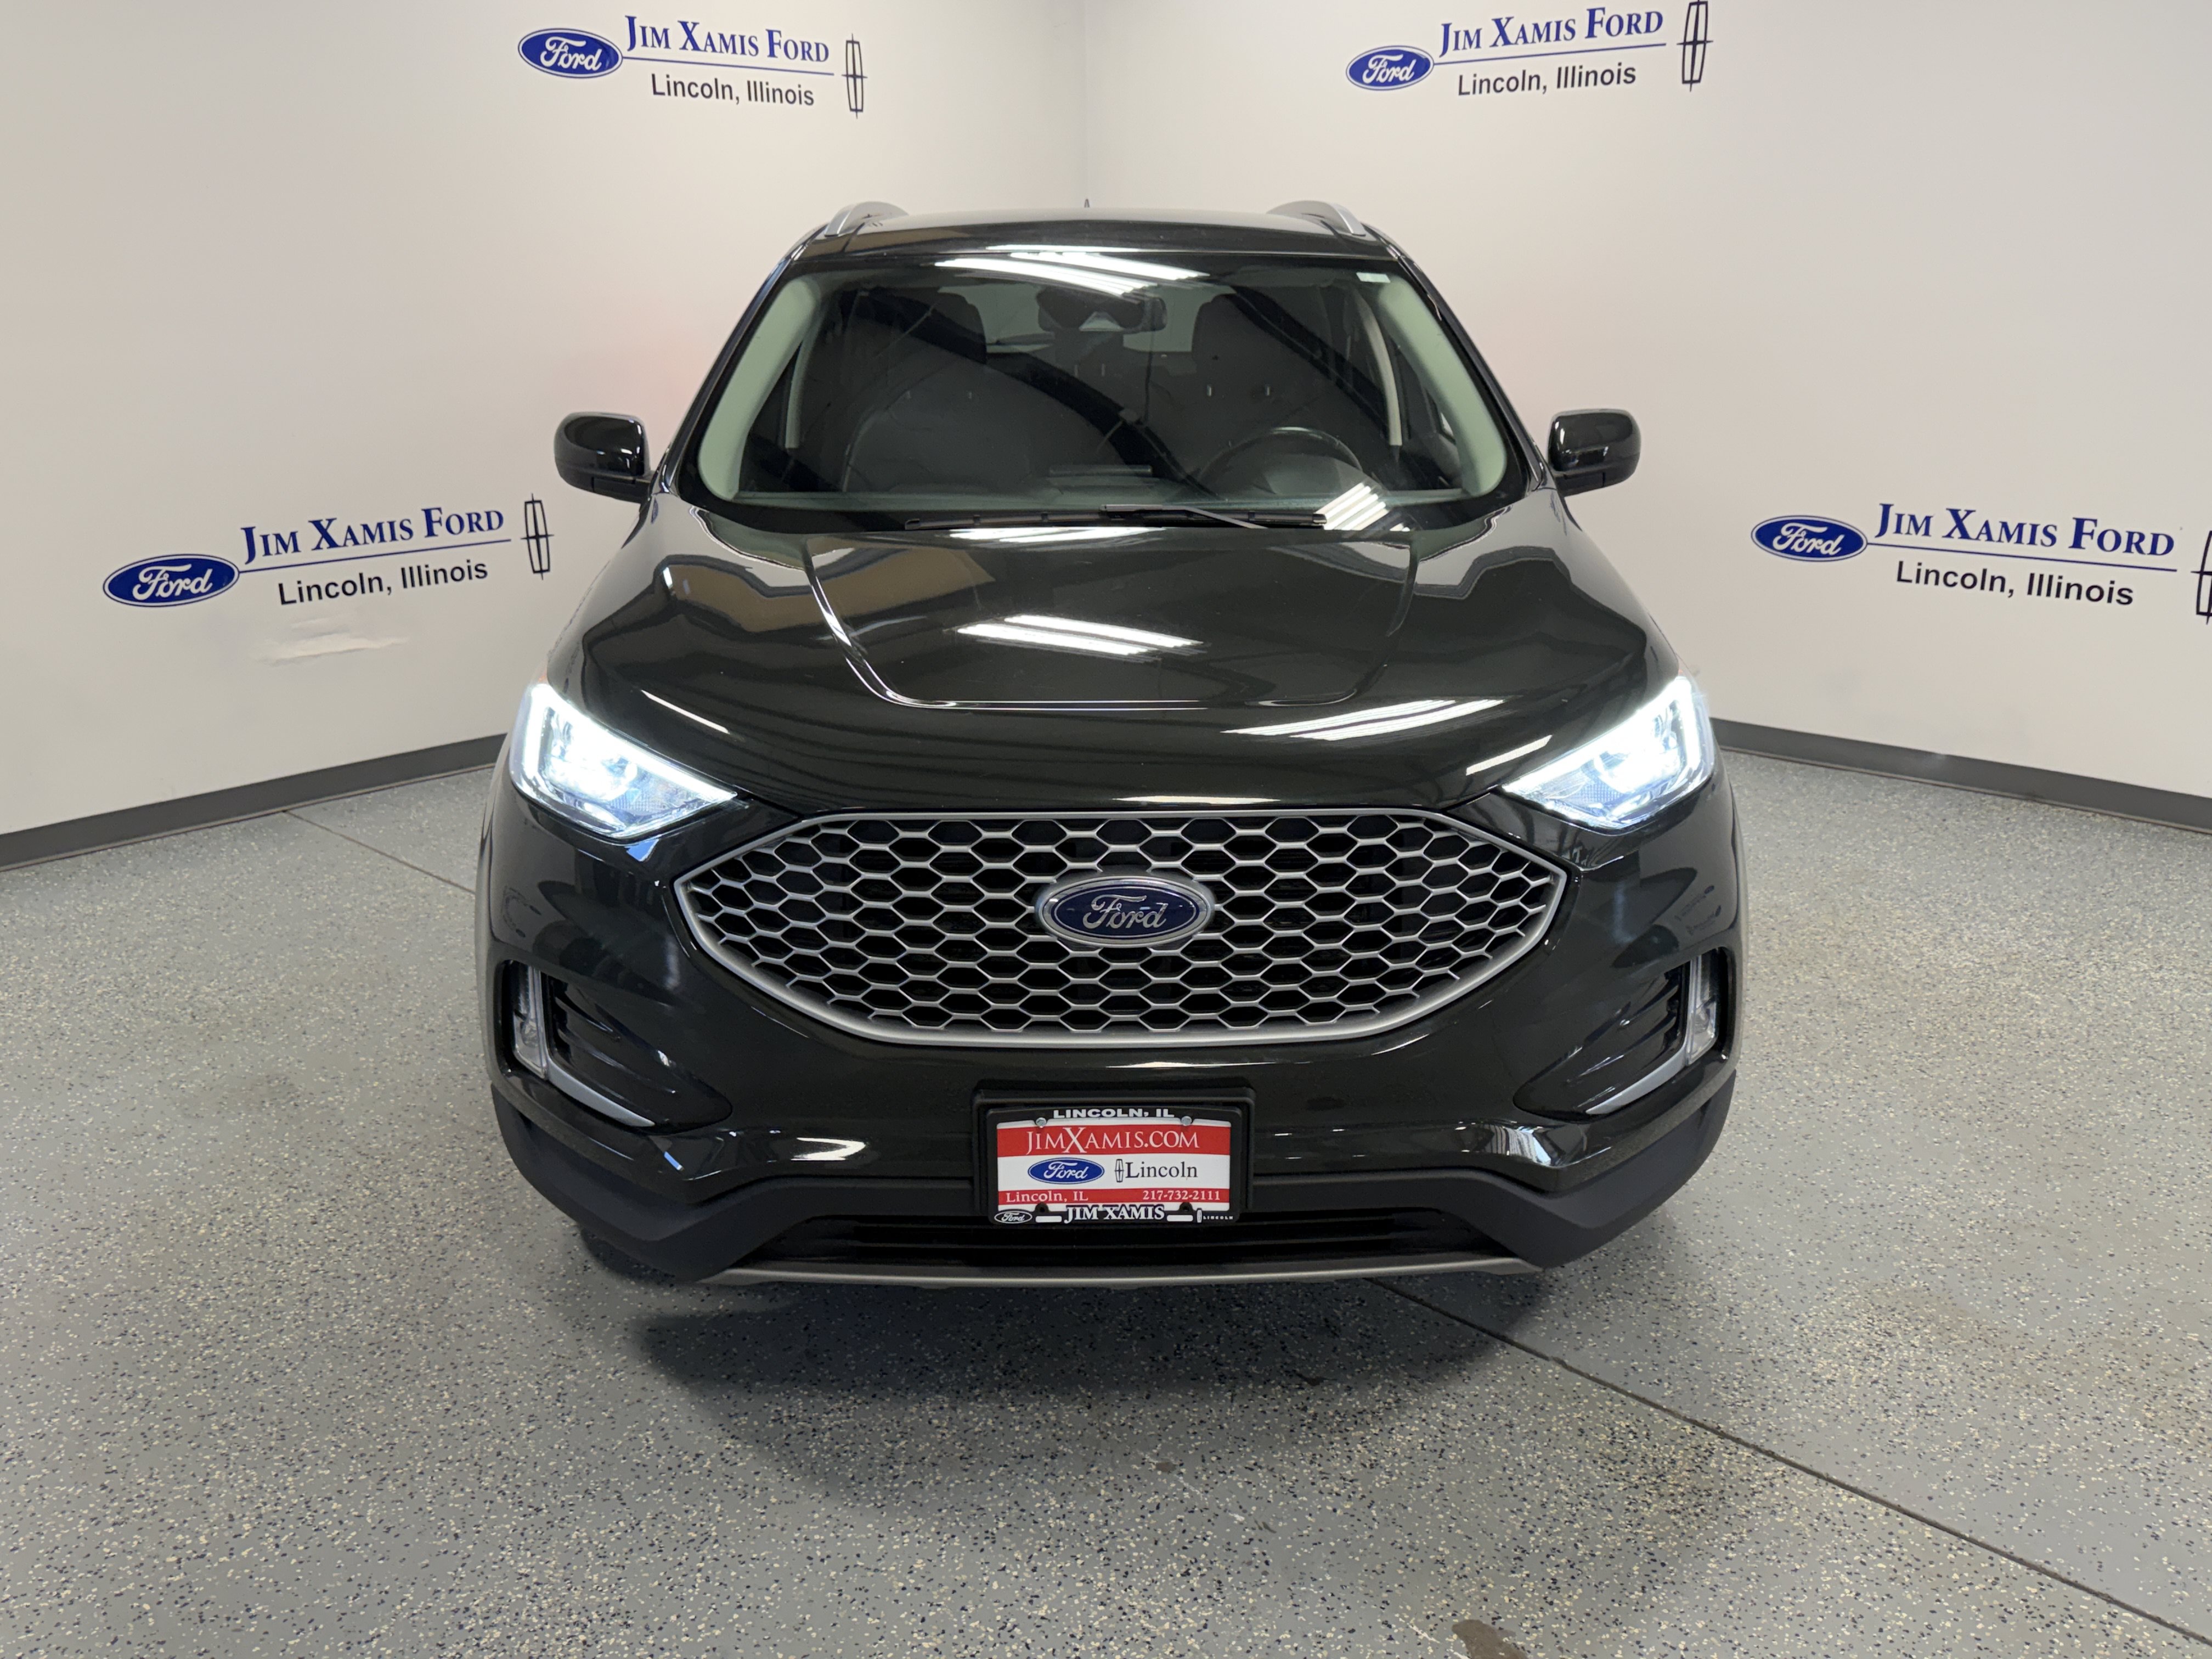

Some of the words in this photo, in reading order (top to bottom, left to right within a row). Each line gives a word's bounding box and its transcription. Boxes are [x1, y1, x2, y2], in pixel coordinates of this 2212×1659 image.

[540, 36, 602, 71] Ford
[1362, 55, 1414, 83] Ford
[1458, 70, 1548, 96] Lincoln,
[1557, 63, 1636, 89] Illinois
[652, 74, 740, 105] Lincoln,
[747, 80, 814, 106] Illinois
[1773, 523, 1842, 556] Ford
[132, 564, 213, 600] Ford
[279, 572, 392, 605] Lincoln,
[401, 559, 488, 590] Illinois
[1897, 561, 2016, 599] Lincoln,
[2027, 573, 2134, 606] Illinois
[1082, 894, 1169, 929] Ford
[1053, 1108, 1149, 1119] LINCOLN,
[1156, 1109, 1175, 1118] IL
[1043, 1161, 1088, 1179] Ford
[1126, 1161, 1198, 1178] Lincoln
[1006, 1191, 1067, 1203] Lincoln,
[1073, 1192, 1088, 1201] IL
[1143, 1190, 1221, 1200] 217-732-2111
[1001, 1212, 1025, 1222] Ford
[1064, 1206, 1099, 1224] JIM
[1103, 1206, 1165, 1220] XAMIS
